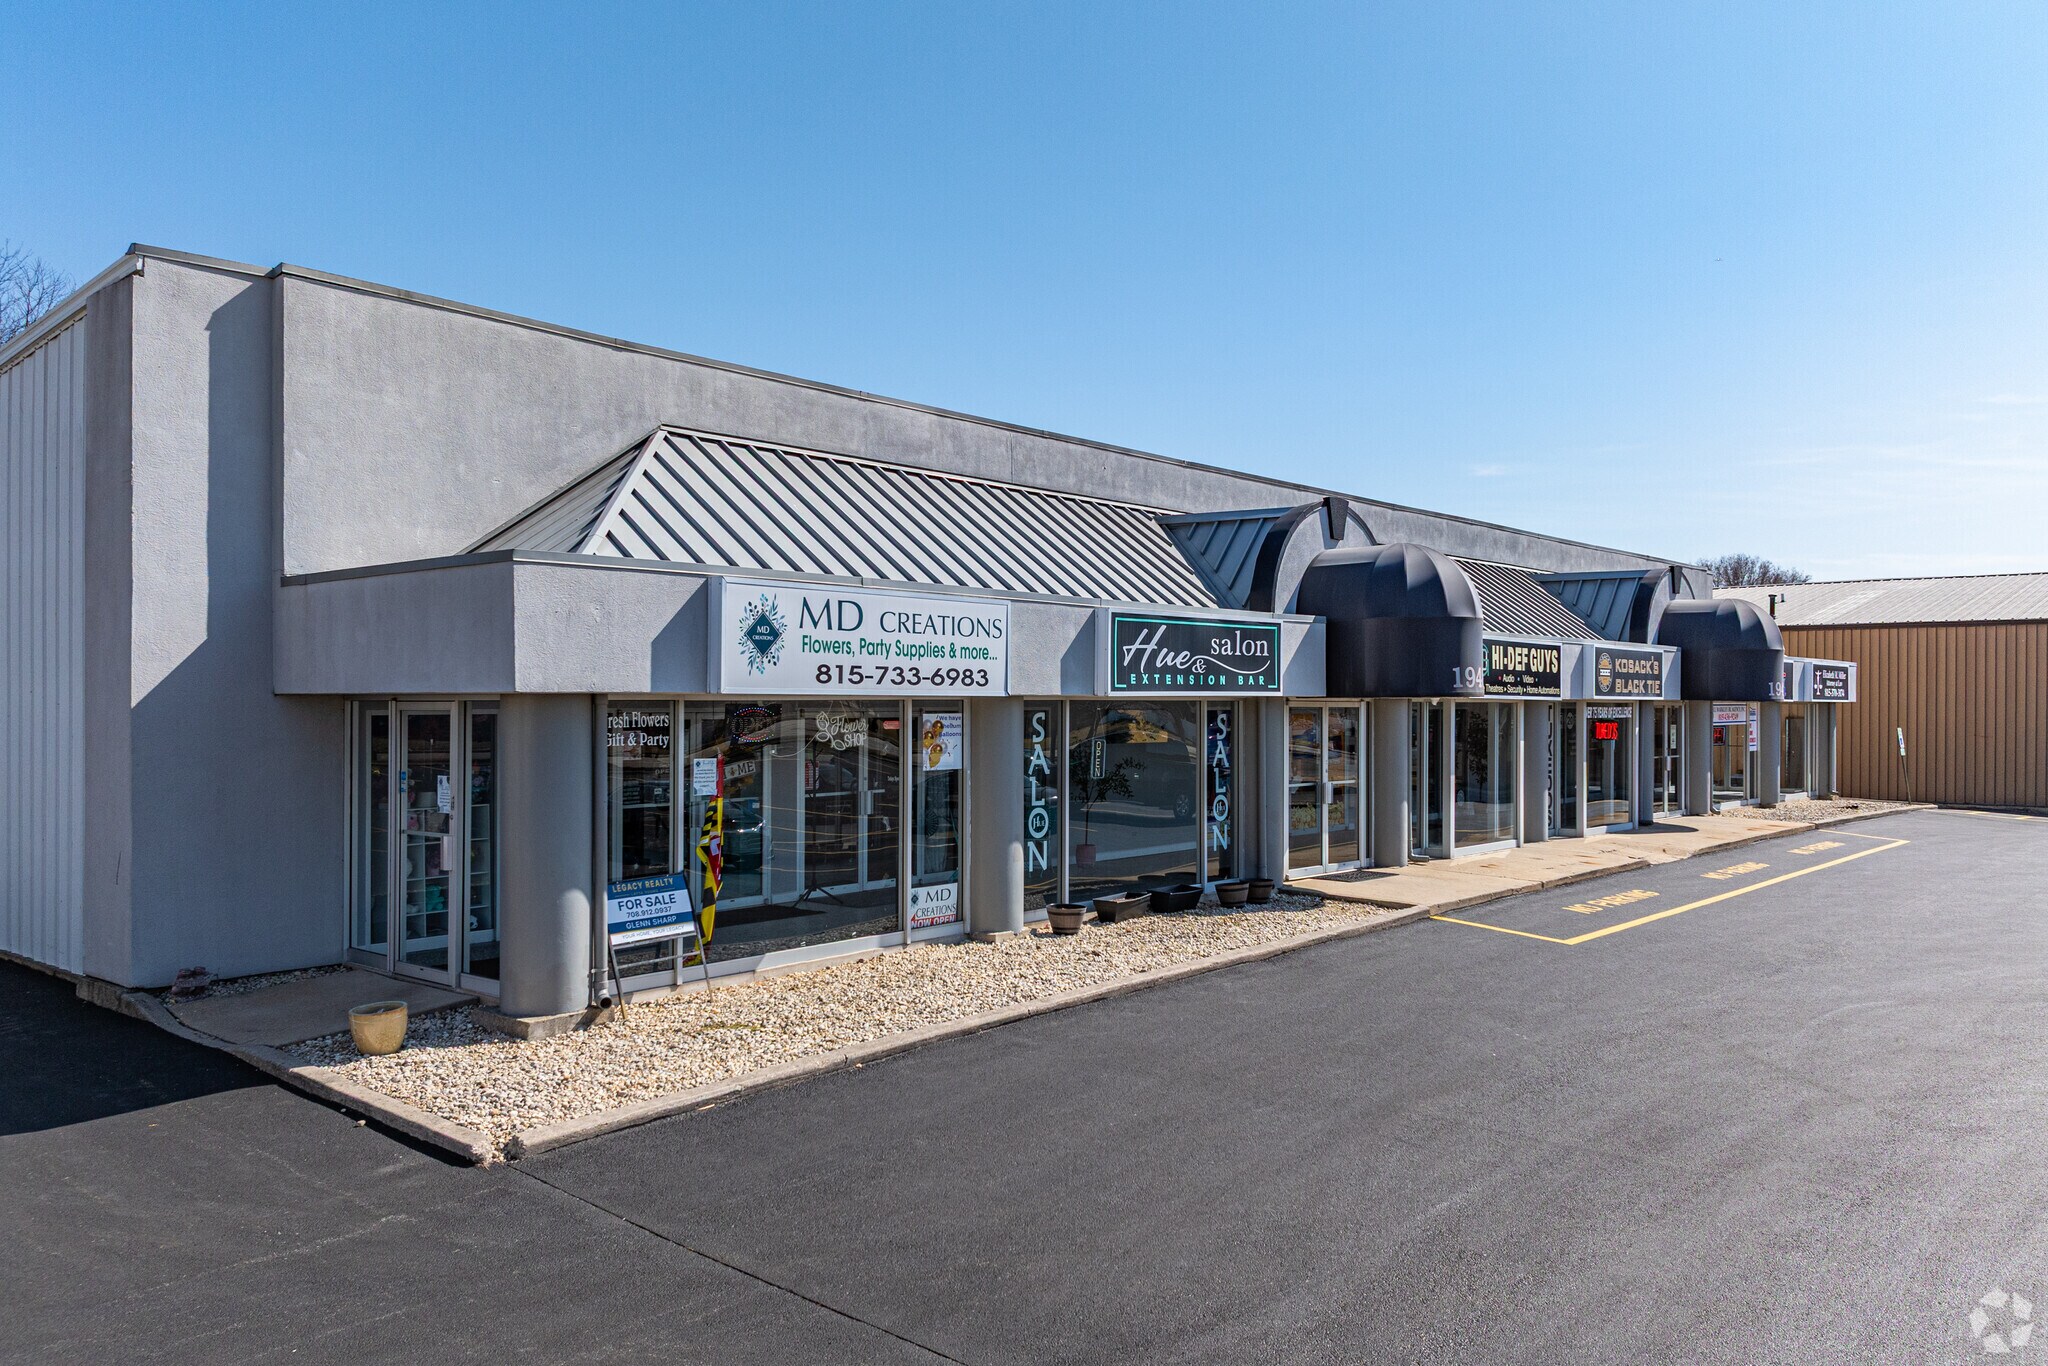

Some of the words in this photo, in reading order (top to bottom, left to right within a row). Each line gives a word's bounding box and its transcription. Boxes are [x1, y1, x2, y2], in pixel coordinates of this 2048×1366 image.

[798, 596, 864, 632] MD
[879, 611, 1003, 639] CREATIONS
[756, 626, 770, 634] MD
[802, 635, 855, 657] Flowers,
[859, 637, 891, 660] Party
[895, 639, 945, 661] Supplies
[948, 642, 957, 658] &
[960, 646, 998, 660] more...
[1122, 624, 1192, 673] Hue
[1192, 658, 1207, 674] &
[1211, 630, 1269, 657] salon
[1491, 645, 1528, 671] HI-DEF
[1529, 648, 1559, 673] GUYS
[1615, 656, 1659, 675] KOSACK'S
[815, 664, 989, 687] 815-733-6983
[1130, 673, 1226, 685] EXTENSION
[1238, 675, 1265, 685] BAR
[1502, 673, 1515, 683] Audio
[1522, 675, 1534, 684] Video
[1485, 683, 1504, 693] Theatres
[1507, 684, 1523, 695] Security
[1527, 685, 1539, 694] Home
[1615, 679, 1645, 693] BLACK
[1647, 680, 1660, 694] TIE
[608, 711, 630, 728] resh
[632, 711, 669, 728] Flowers
[831, 714, 869, 735] Flower
[627, 732, 637, 746] &
[640, 732, 670, 748] Party
[844, 732, 867, 748] SHOP
[1212, 713, 1230, 852] SALON
[1028, 712, 1050, 872] SALON
[612, 882, 643, 893] LEGACY
[645, 878, 673, 888] REALTY
[618, 898, 643, 911] FOR
[646, 894, 677, 907] SALE
[925, 888, 951, 903] MD
[626, 906, 672, 918] 708.912.0937
[915, 903, 957, 918] CREATIONS
[1561, 903, 1604, 914] NO
[626, 920, 651, 929] GLENN
[653, 916, 677, 925] SHARP
[911, 918, 931, 929] NOW
[933, 914, 955, 925] OPEN
